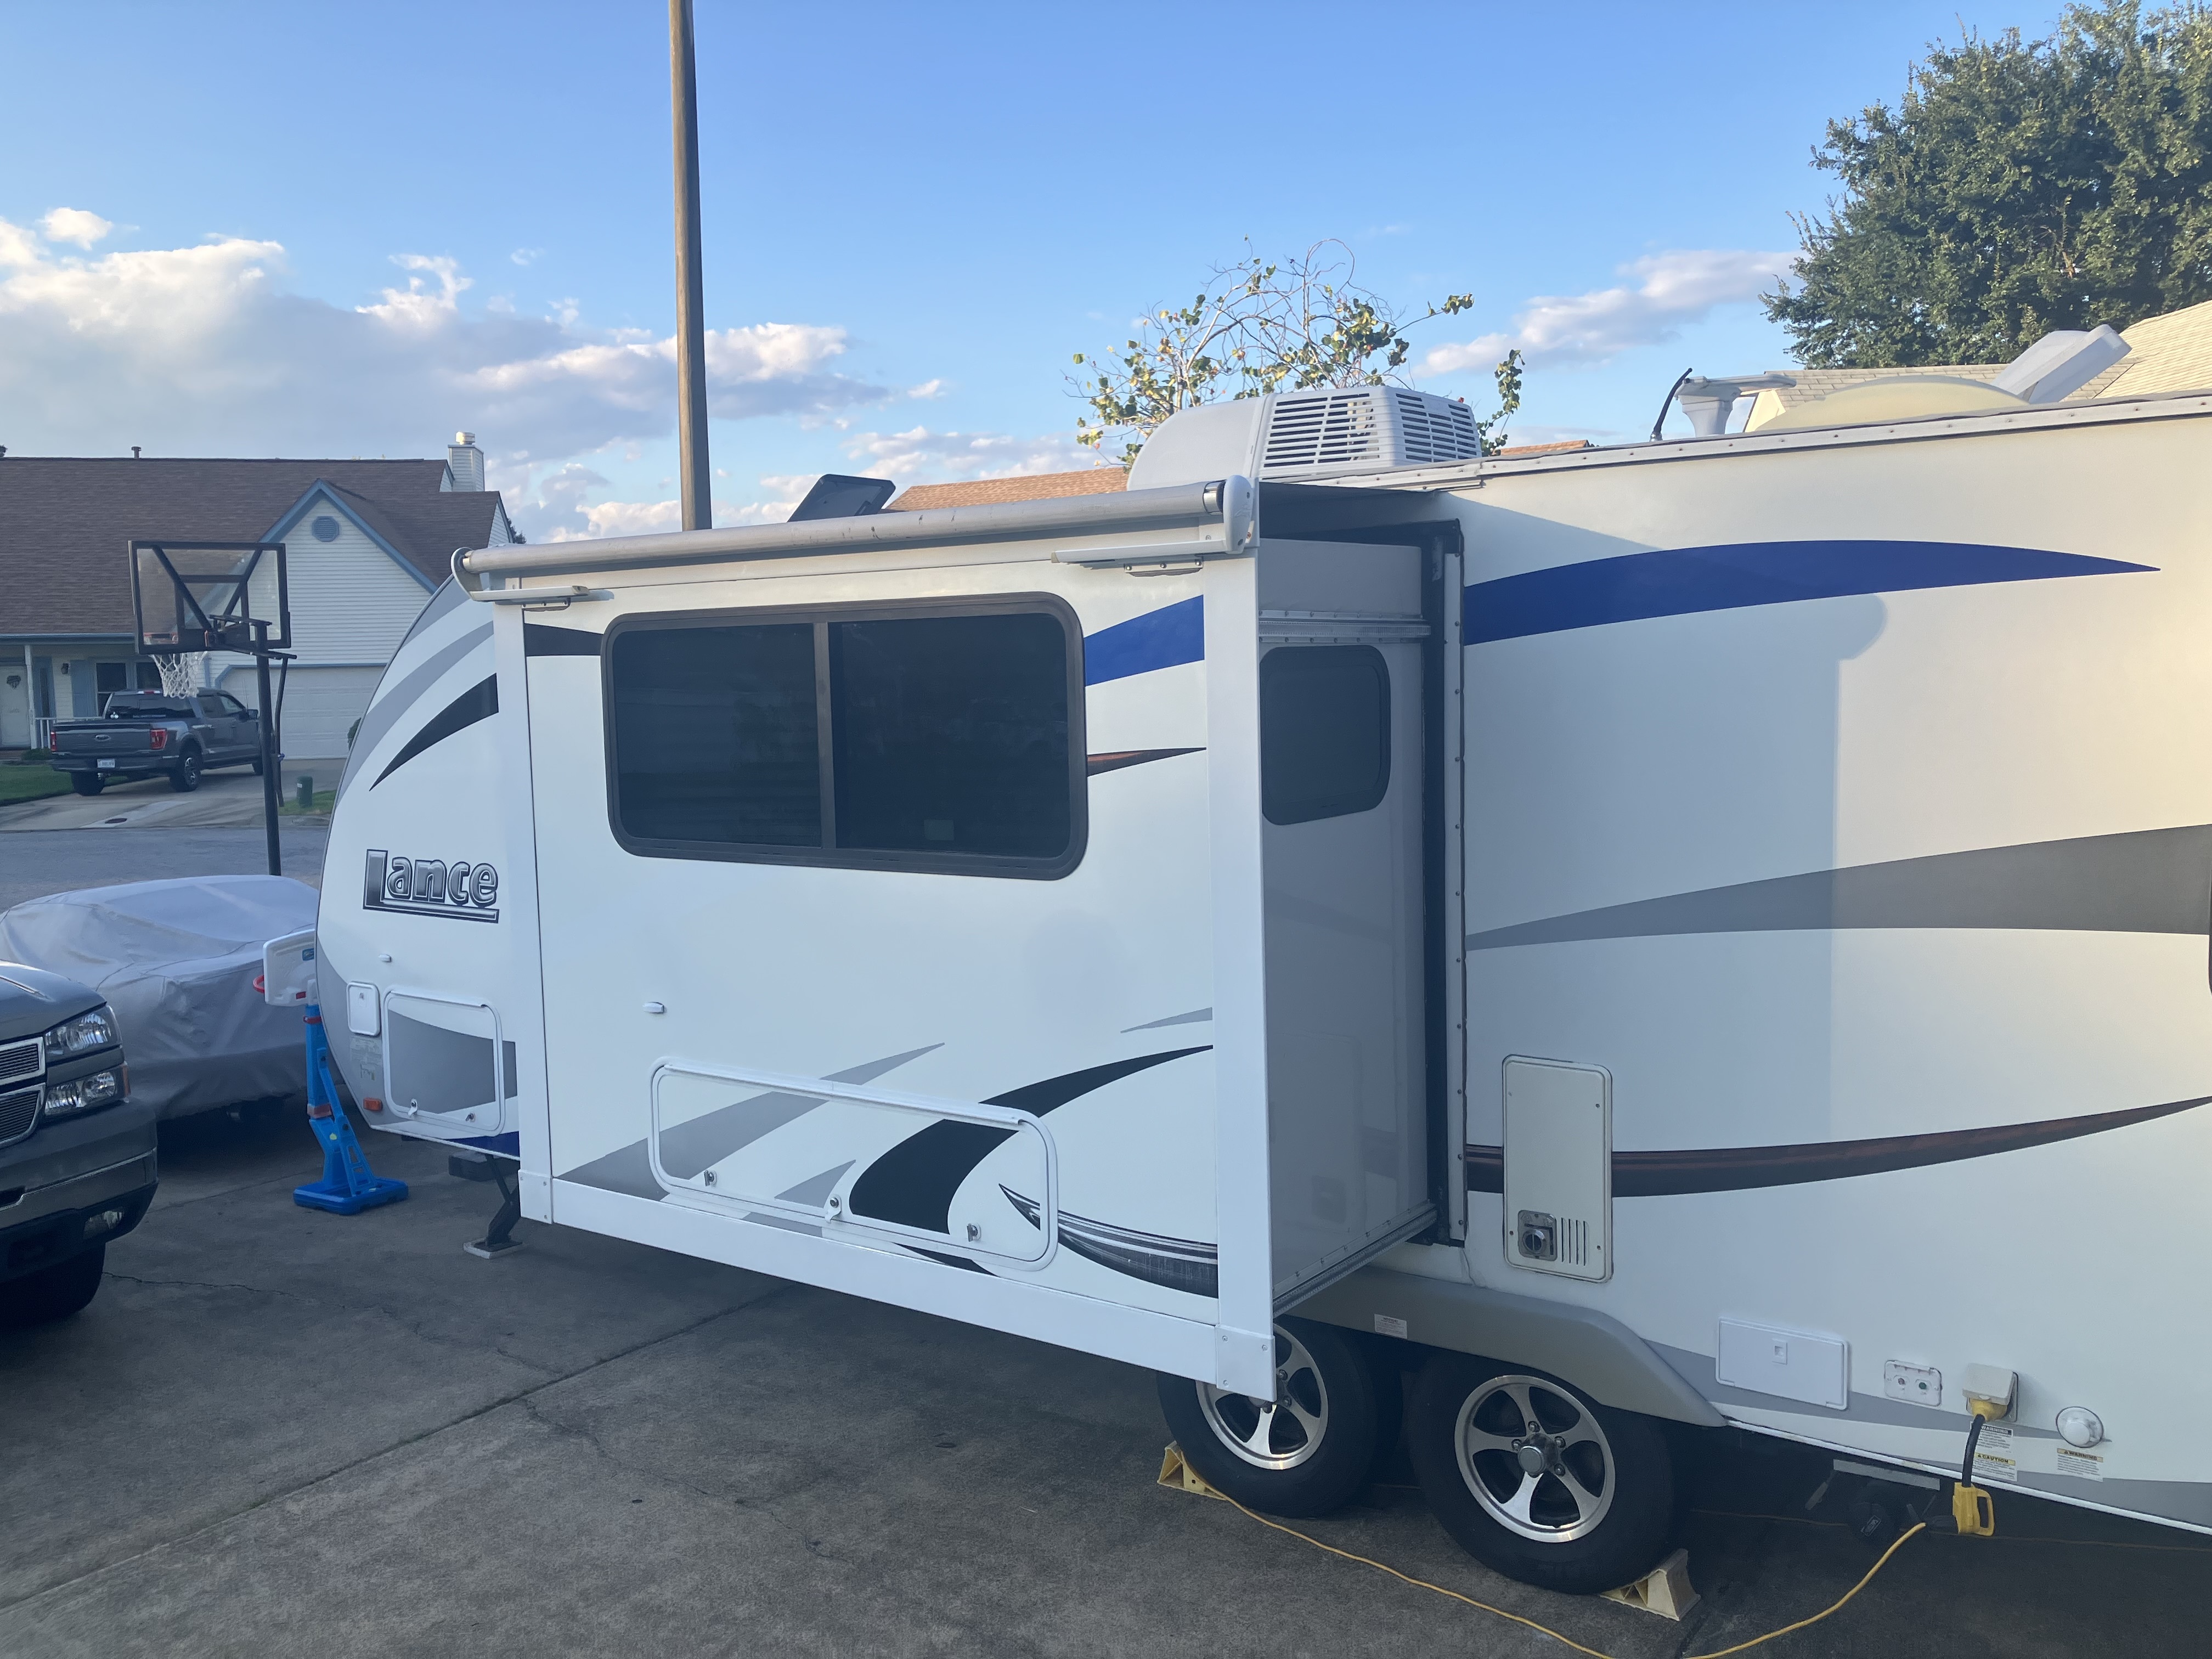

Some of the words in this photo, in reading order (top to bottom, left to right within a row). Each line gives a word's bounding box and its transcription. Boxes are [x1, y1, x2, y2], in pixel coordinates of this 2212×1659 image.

[363, 849, 499, 923] Lance
[1982, 1425, 2008, 1434] WARNING
[1982, 1454, 2008, 1463] CAUTION
[2069, 1451, 2097, 1460] WARNING
